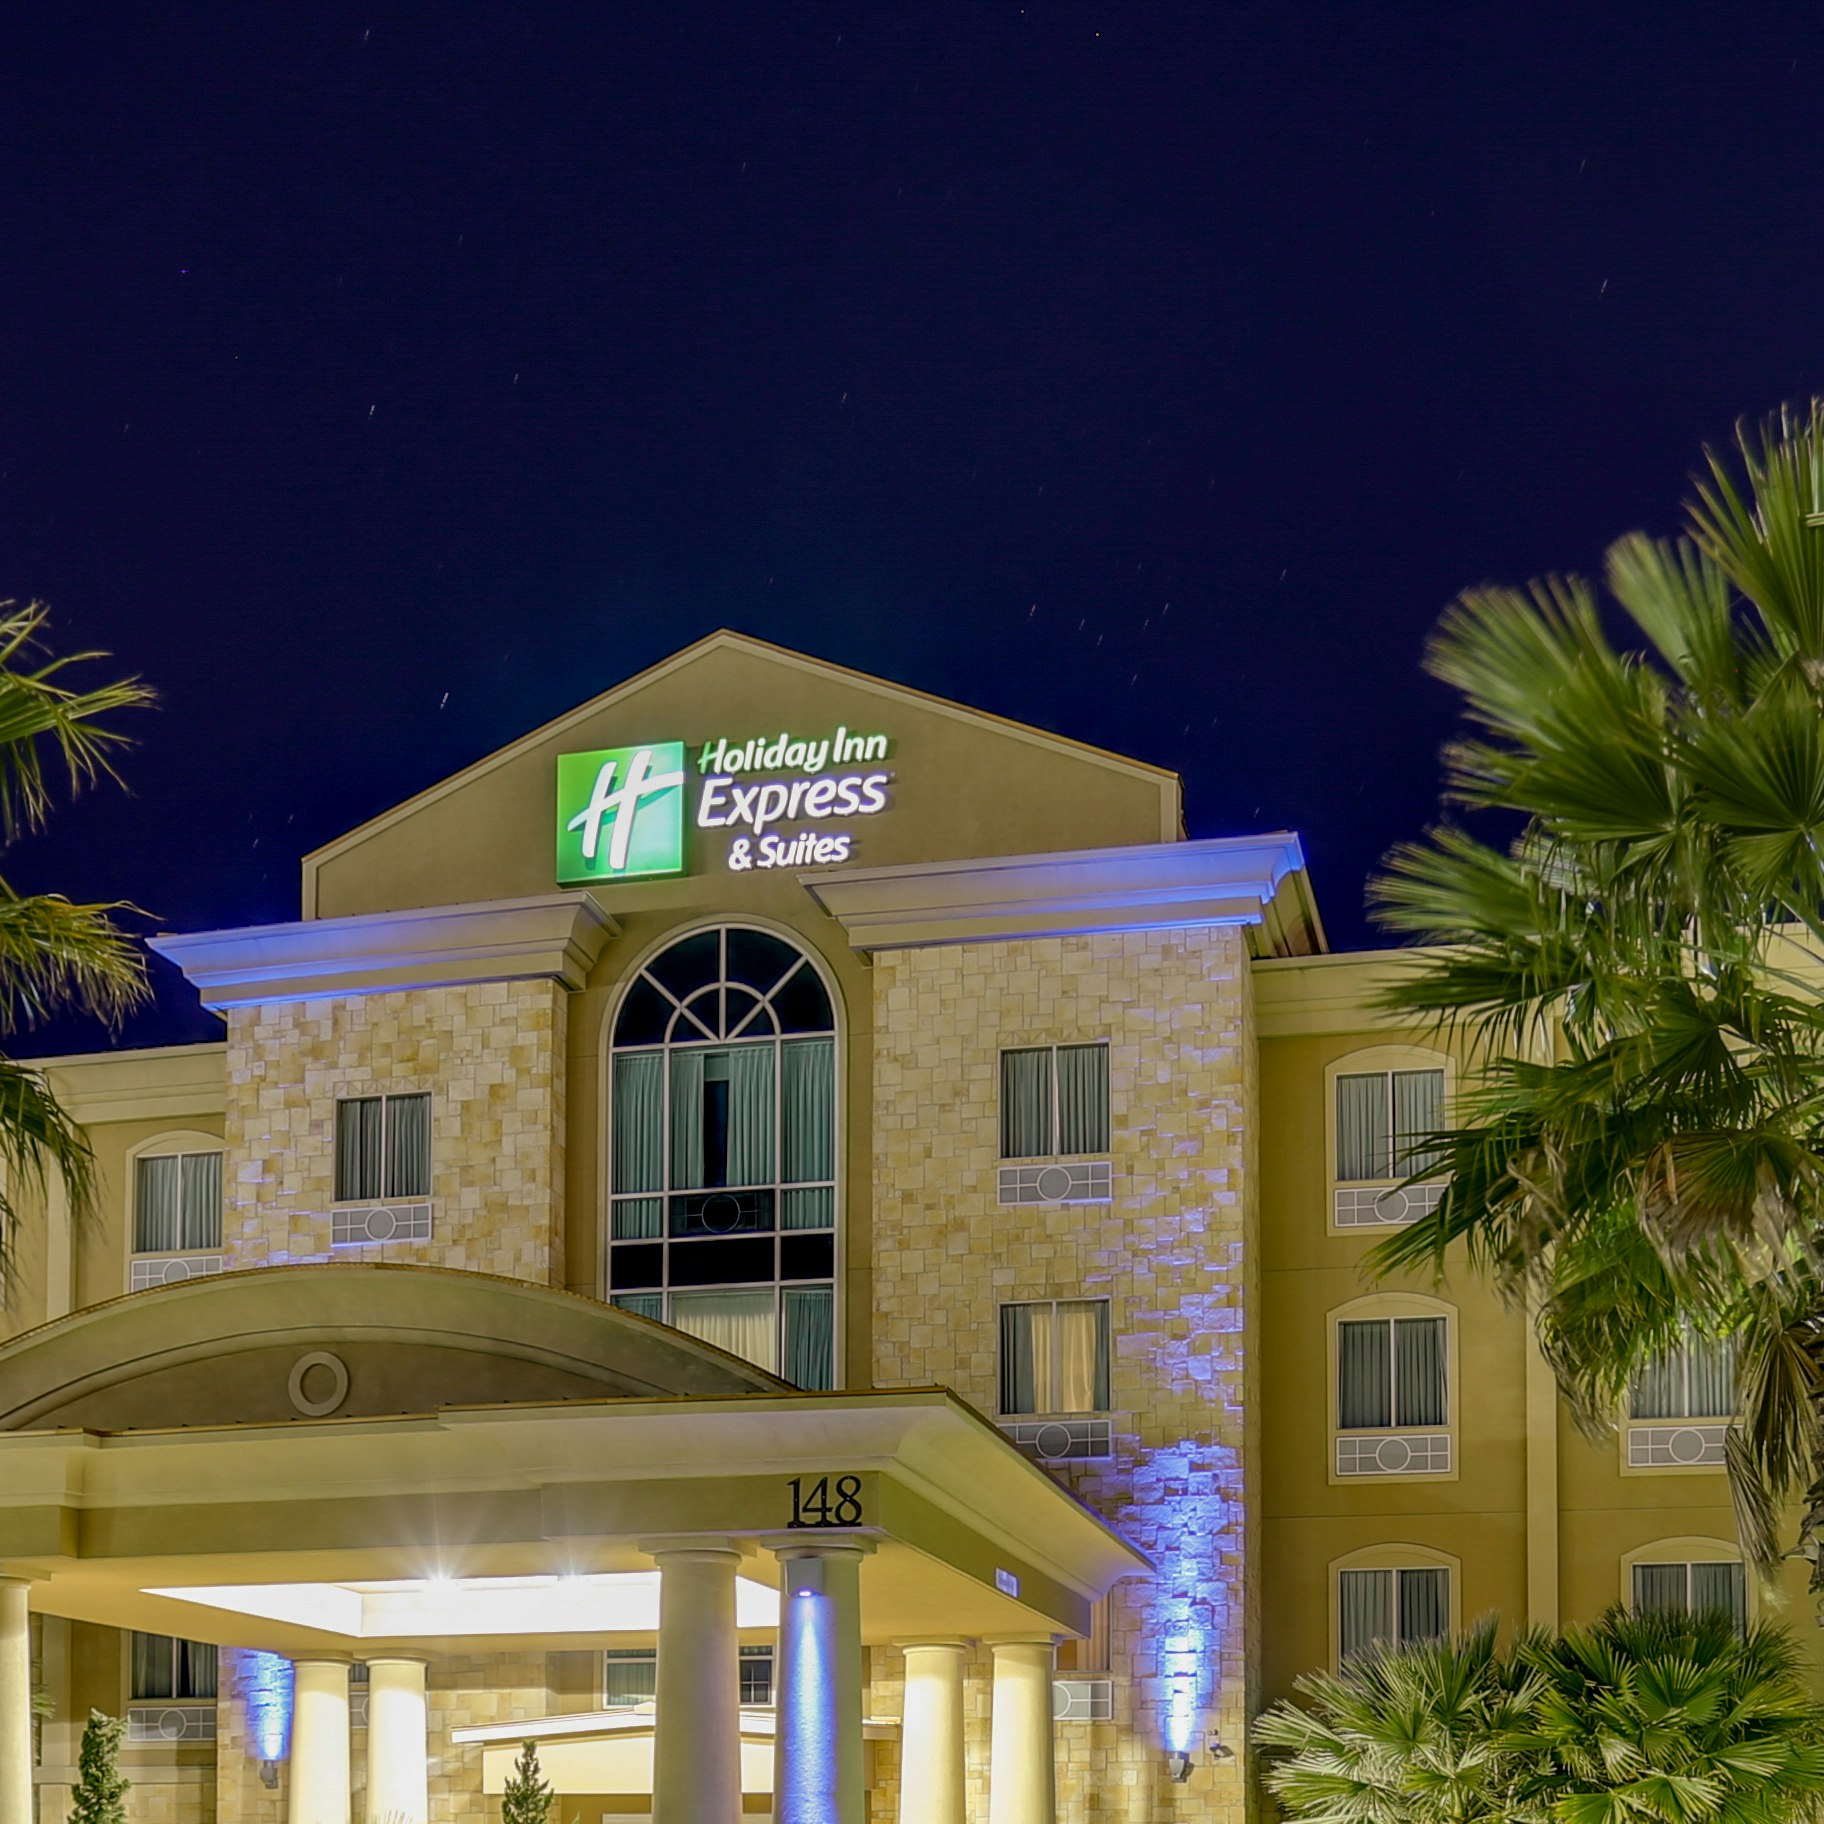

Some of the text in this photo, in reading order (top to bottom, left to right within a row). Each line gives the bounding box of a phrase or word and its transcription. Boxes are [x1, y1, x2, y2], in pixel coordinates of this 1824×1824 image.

[697, 727, 887, 774] Holiday Inn
[698, 775, 887, 835] Express
[728, 833, 850, 870] & Suites
[787, 1476, 862, 1528] 148
